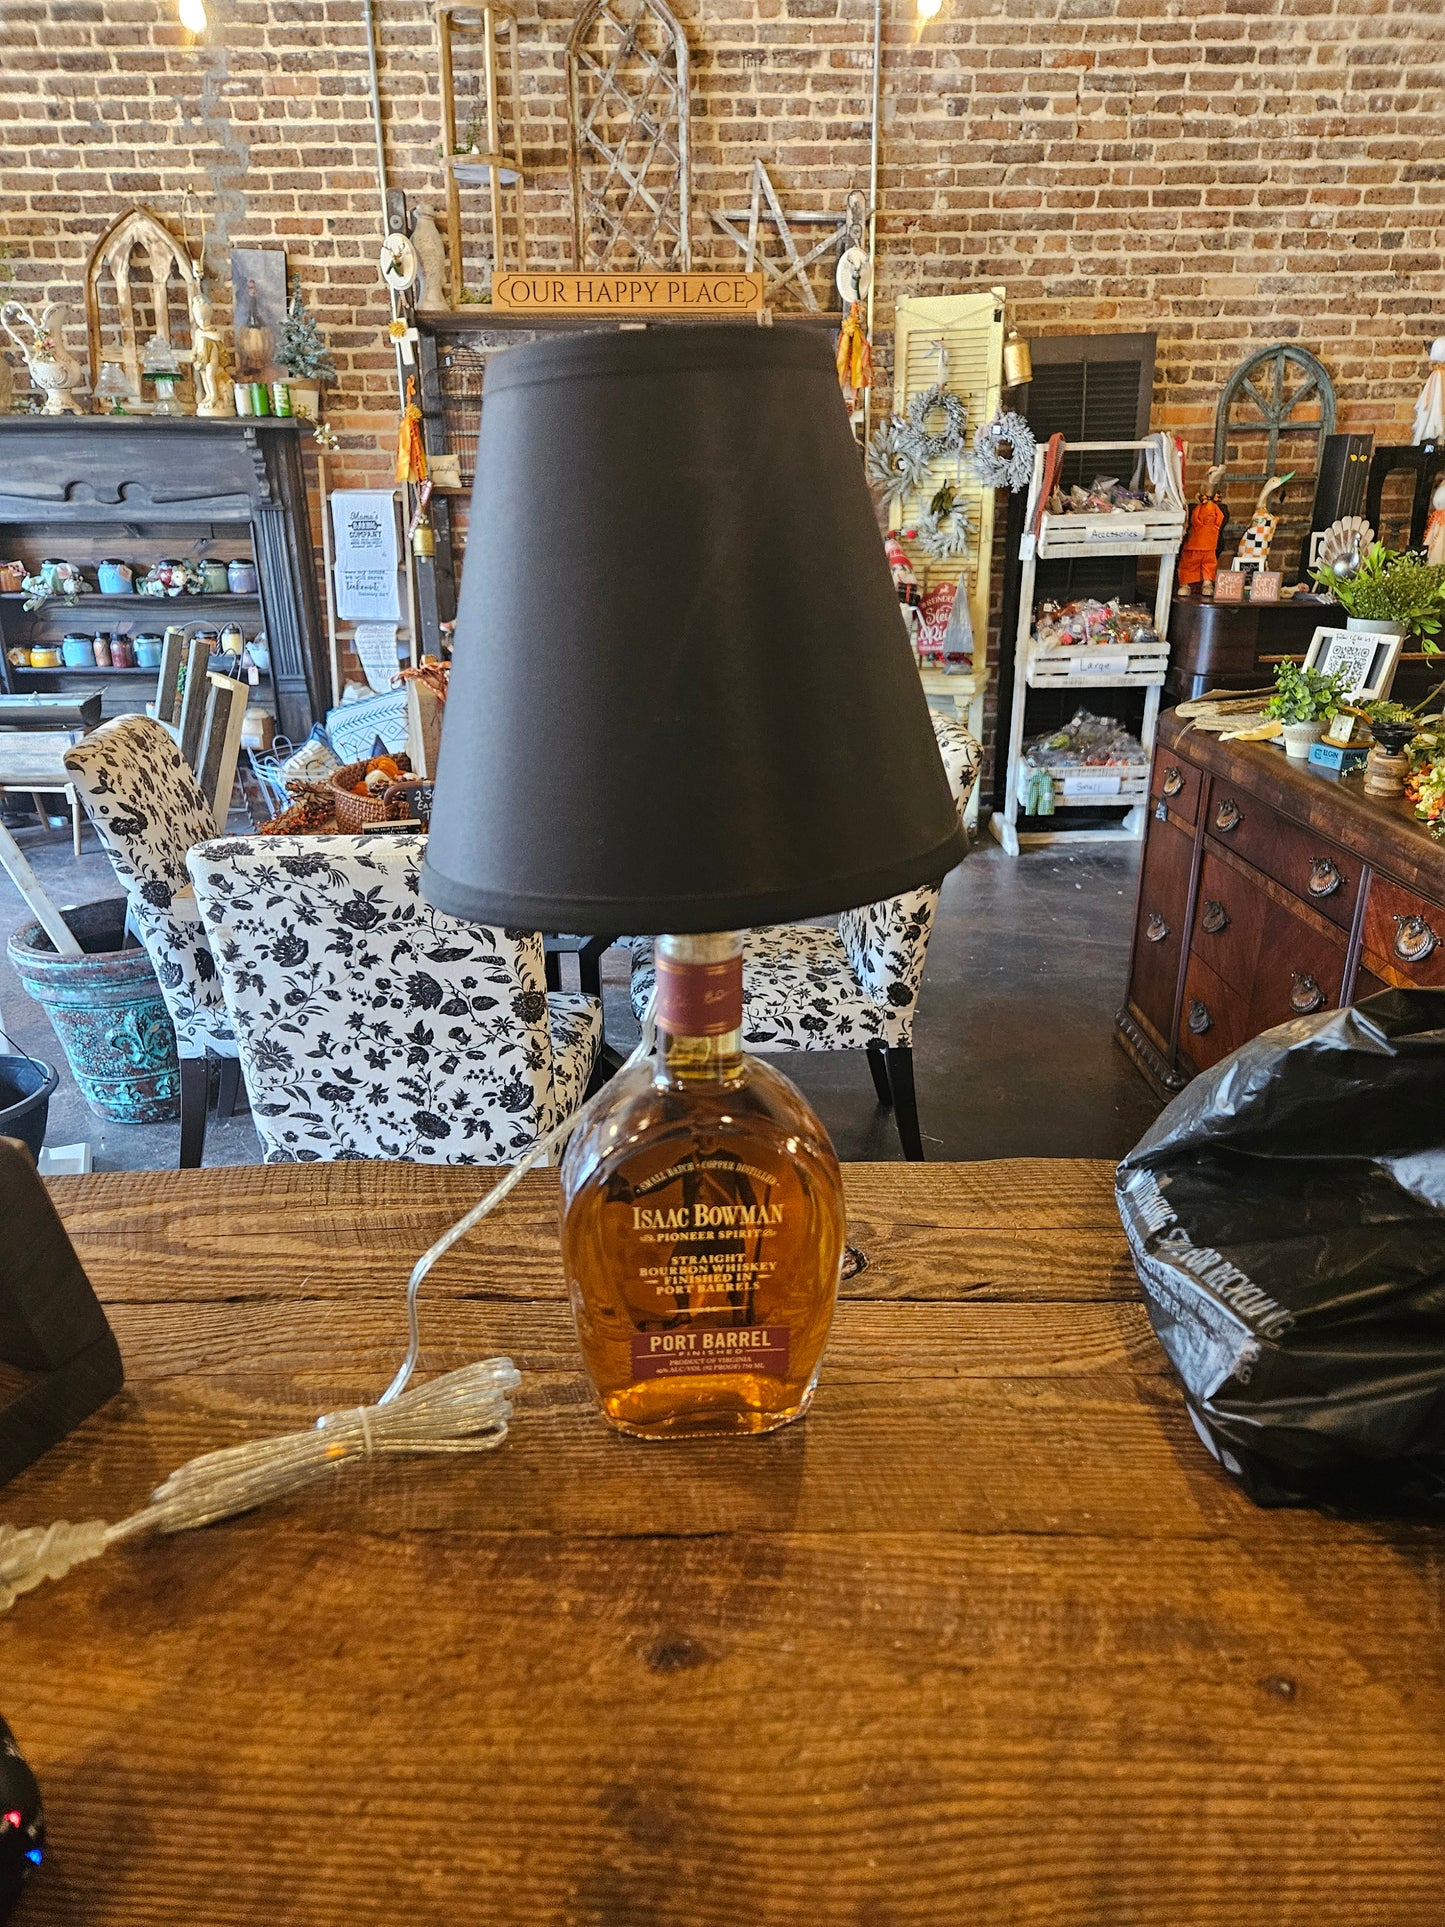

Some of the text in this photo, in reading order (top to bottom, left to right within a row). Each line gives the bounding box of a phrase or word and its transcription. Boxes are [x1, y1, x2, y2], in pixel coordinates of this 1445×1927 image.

[511, 280, 747, 303] OUR HAPPY PLACE
[1091, 529, 1138, 539] Accessories
[1080, 657, 1110, 672] Large
[1322, 748, 1339, 759] ELGIN
[1076, 782, 1100, 793] Small
[639, 1160, 777, 1193] SMALL BATCH COPPER DISTILLED
[631, 1203, 785, 1230] ISAAC BOWMAN
[656, 1229, 761, 1243] PIONEER SPIRIT
[671, 1253, 746, 1266] STRAIGHT
[639, 1261, 778, 1277] BOURBON WHISKEY
[664, 1271, 752, 1286] FINISHED IN
[655, 1281, 761, 1296] PORT BARRELS
[1201, 1261, 1297, 1338] RECYCLING
[650, 1330, 772, 1352] PORT BARREL
[678, 1348, 743, 1357] FINISHED
[669, 1356, 752, 1367] PRODUCT OF VIRGINIA
